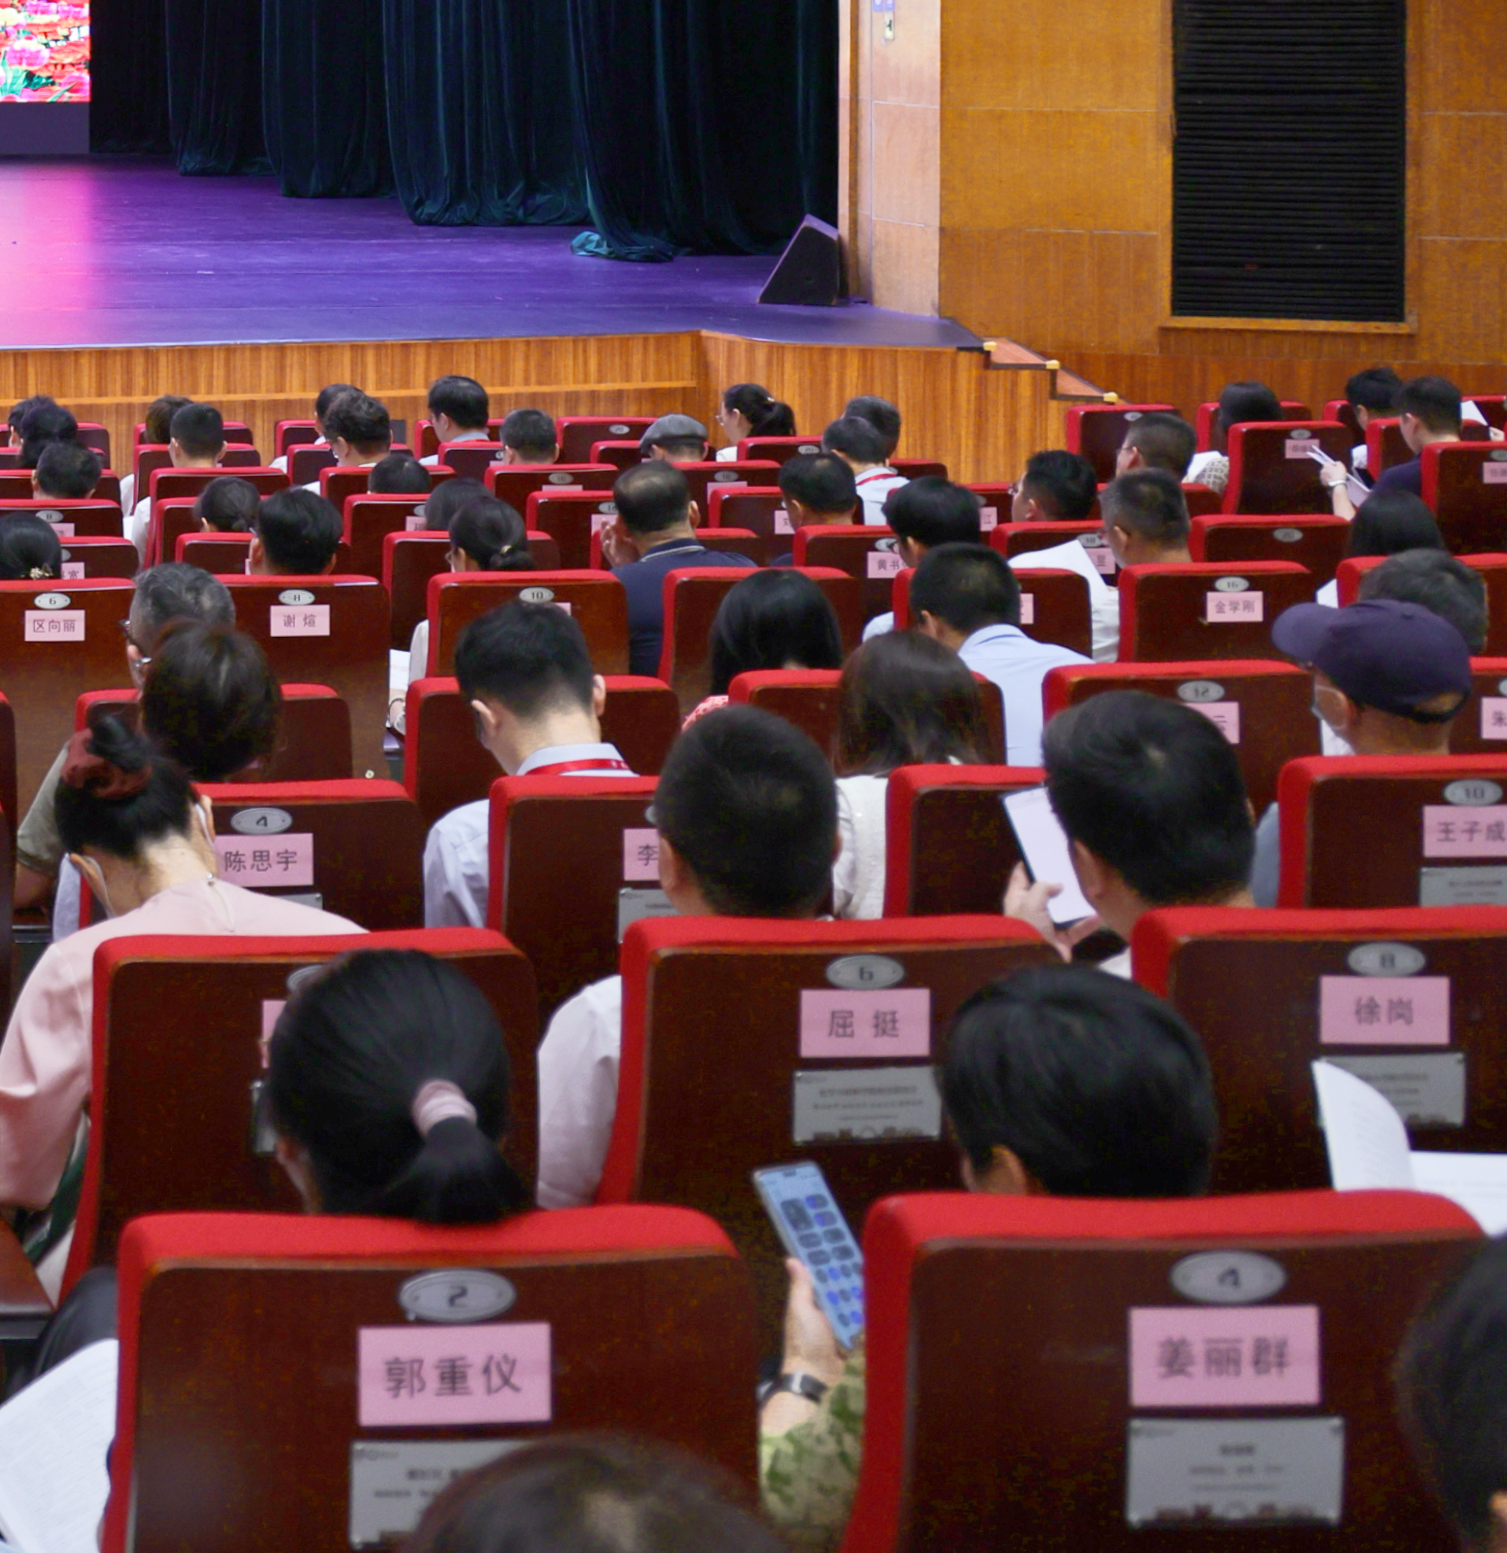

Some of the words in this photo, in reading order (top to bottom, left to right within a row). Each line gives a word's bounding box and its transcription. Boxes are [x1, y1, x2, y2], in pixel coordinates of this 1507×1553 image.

[1215, 600, 1254, 614] 金学刚
[33, 619, 76, 633] 区向丽
[257, 816, 268, 827] 4
[222, 849, 297, 872] 陈思宇
[859, 966, 873, 981] 6
[828, 1010, 899, 1038] 屈挺
[449, 1285, 468, 1306] 2
[1159, 1338, 1290, 1378] 姜丽群
[385, 1354, 521, 1398] 郭重仪
